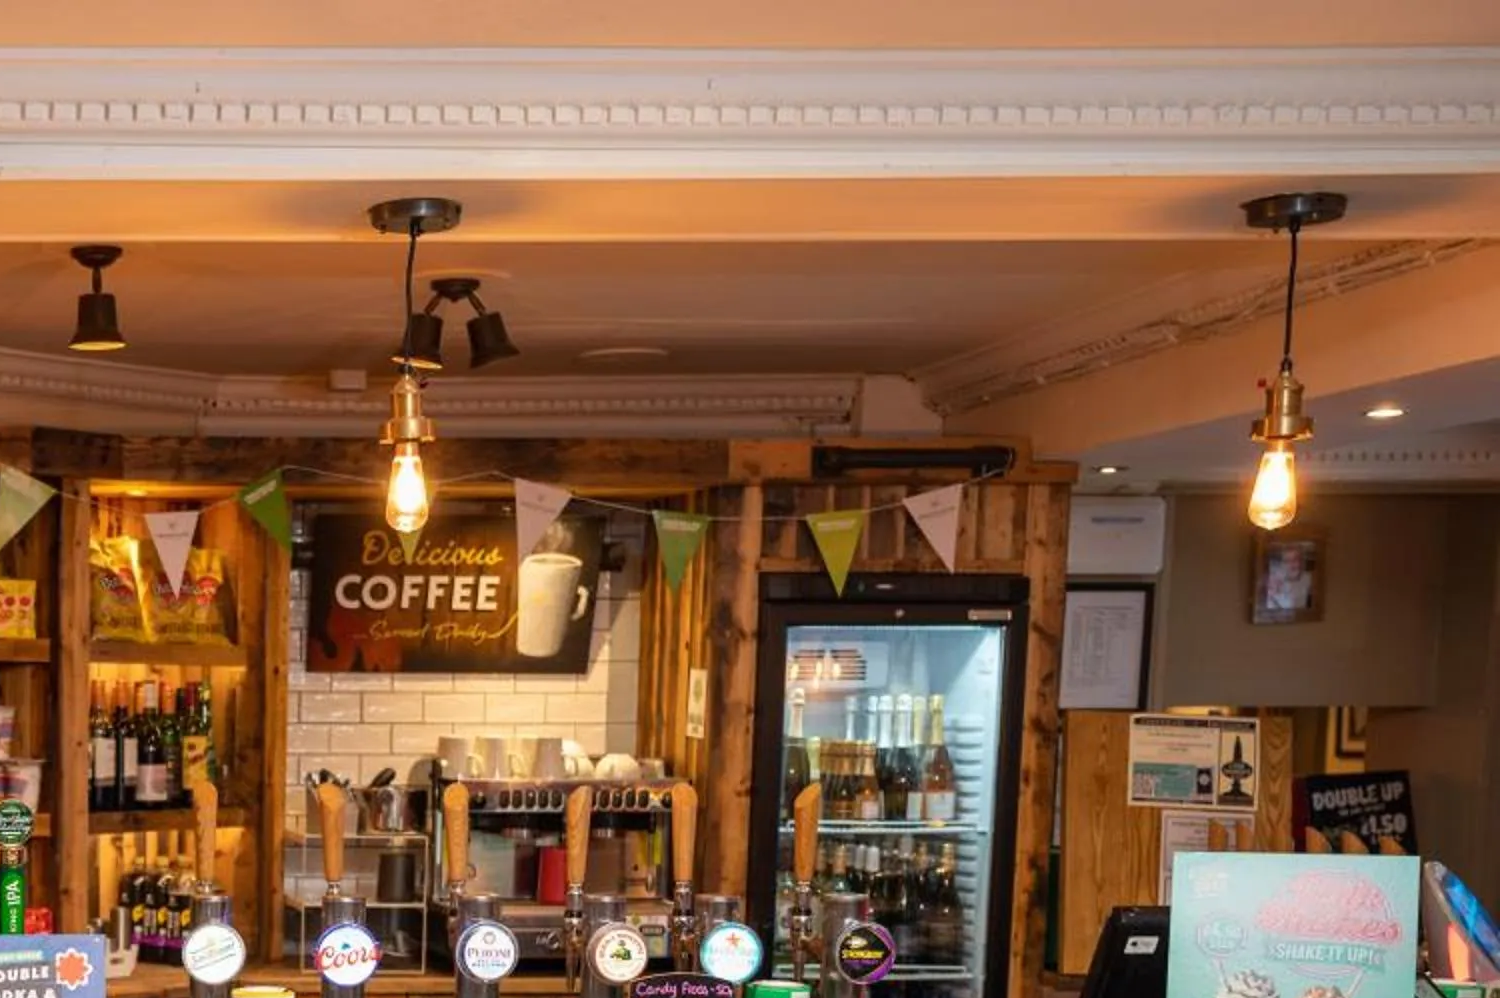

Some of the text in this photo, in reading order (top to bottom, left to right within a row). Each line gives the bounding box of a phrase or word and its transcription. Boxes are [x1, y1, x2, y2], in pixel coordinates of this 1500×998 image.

[335, 574, 501, 611] COFFEE
[1312, 785, 1377, 811] DOUBLE
[1381, 782, 1404, 802] UP
[5, 879, 21, 906] IPA
[315, 941, 383, 973] Coors
[467, 947, 511, 959] PERONI
[1276, 943, 1325, 961] SHAKE
[1329, 944, 1342, 961] IT
[635, 982, 678, 998] Candy
